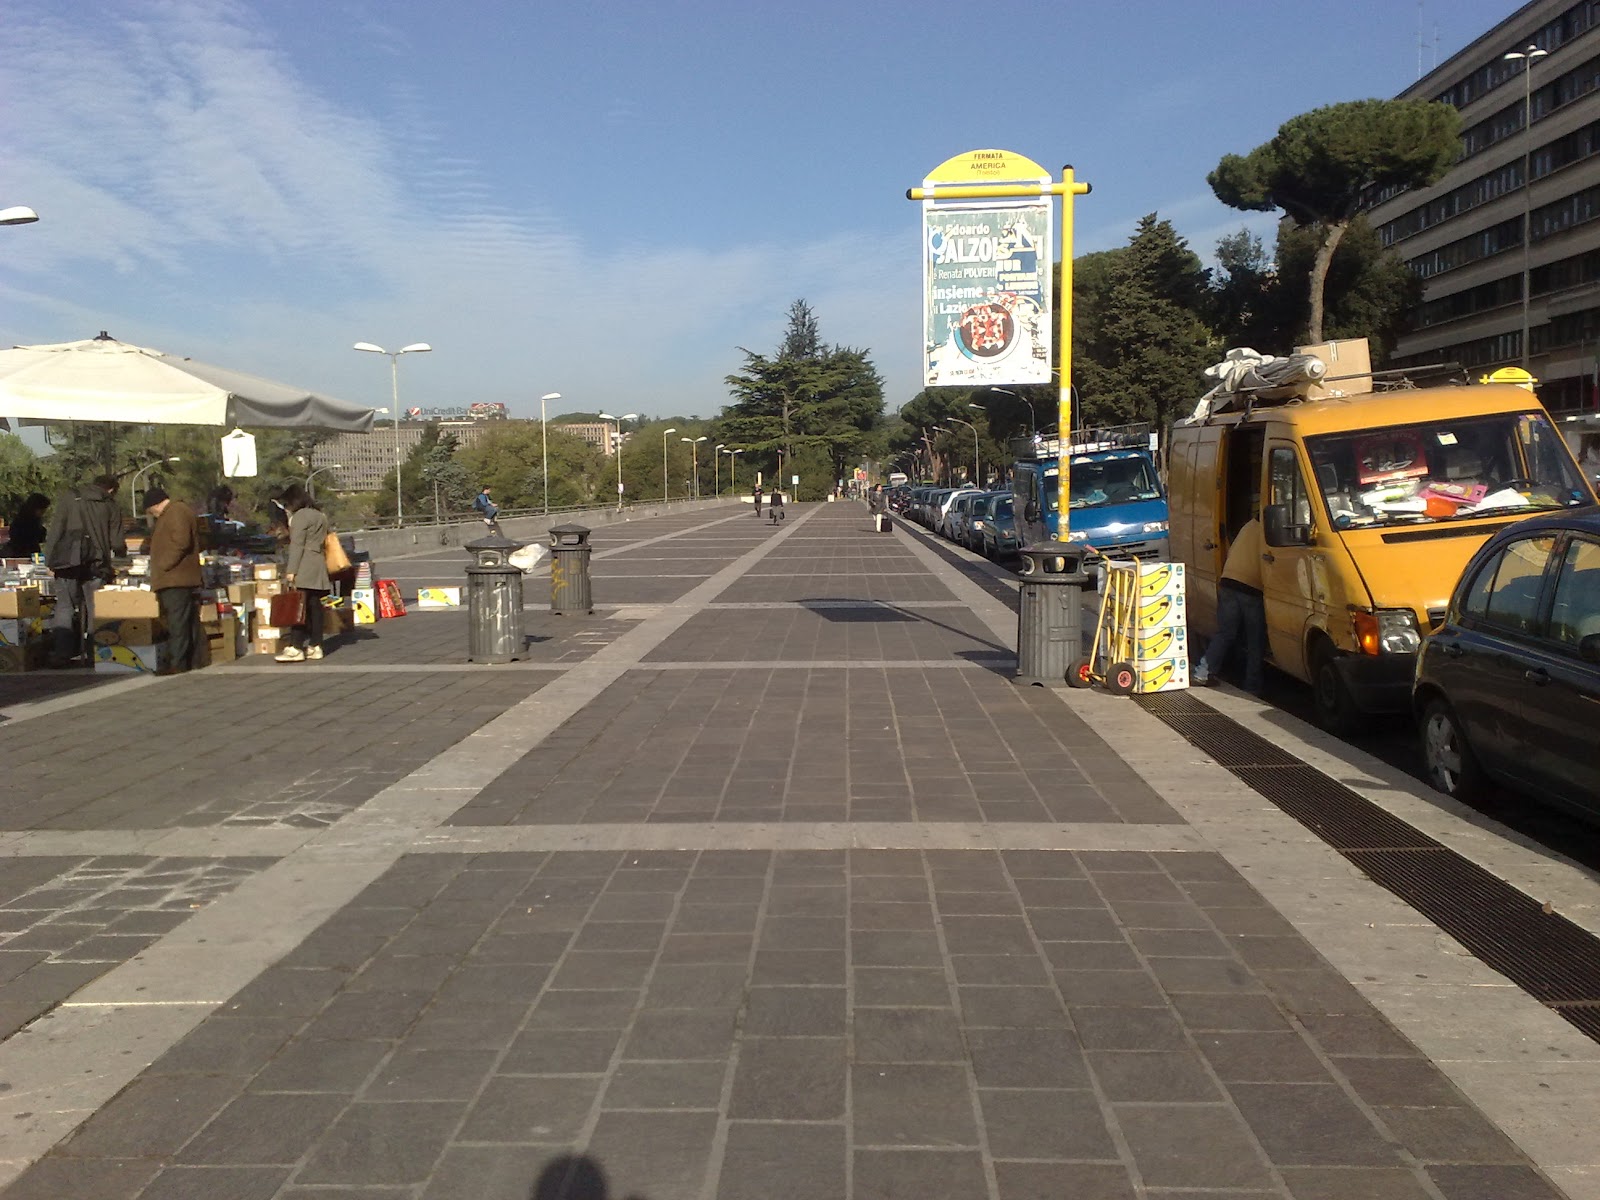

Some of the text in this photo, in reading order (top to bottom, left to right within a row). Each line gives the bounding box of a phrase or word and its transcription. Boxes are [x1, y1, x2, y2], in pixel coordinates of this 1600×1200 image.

[973, 152, 1003, 160] FERMATA
[970, 162, 1006, 170] AMERICA
[938, 269, 963, 280] Renata
[932, 285, 983, 300] insieme
[420, 406, 455, 415] UniCredit
